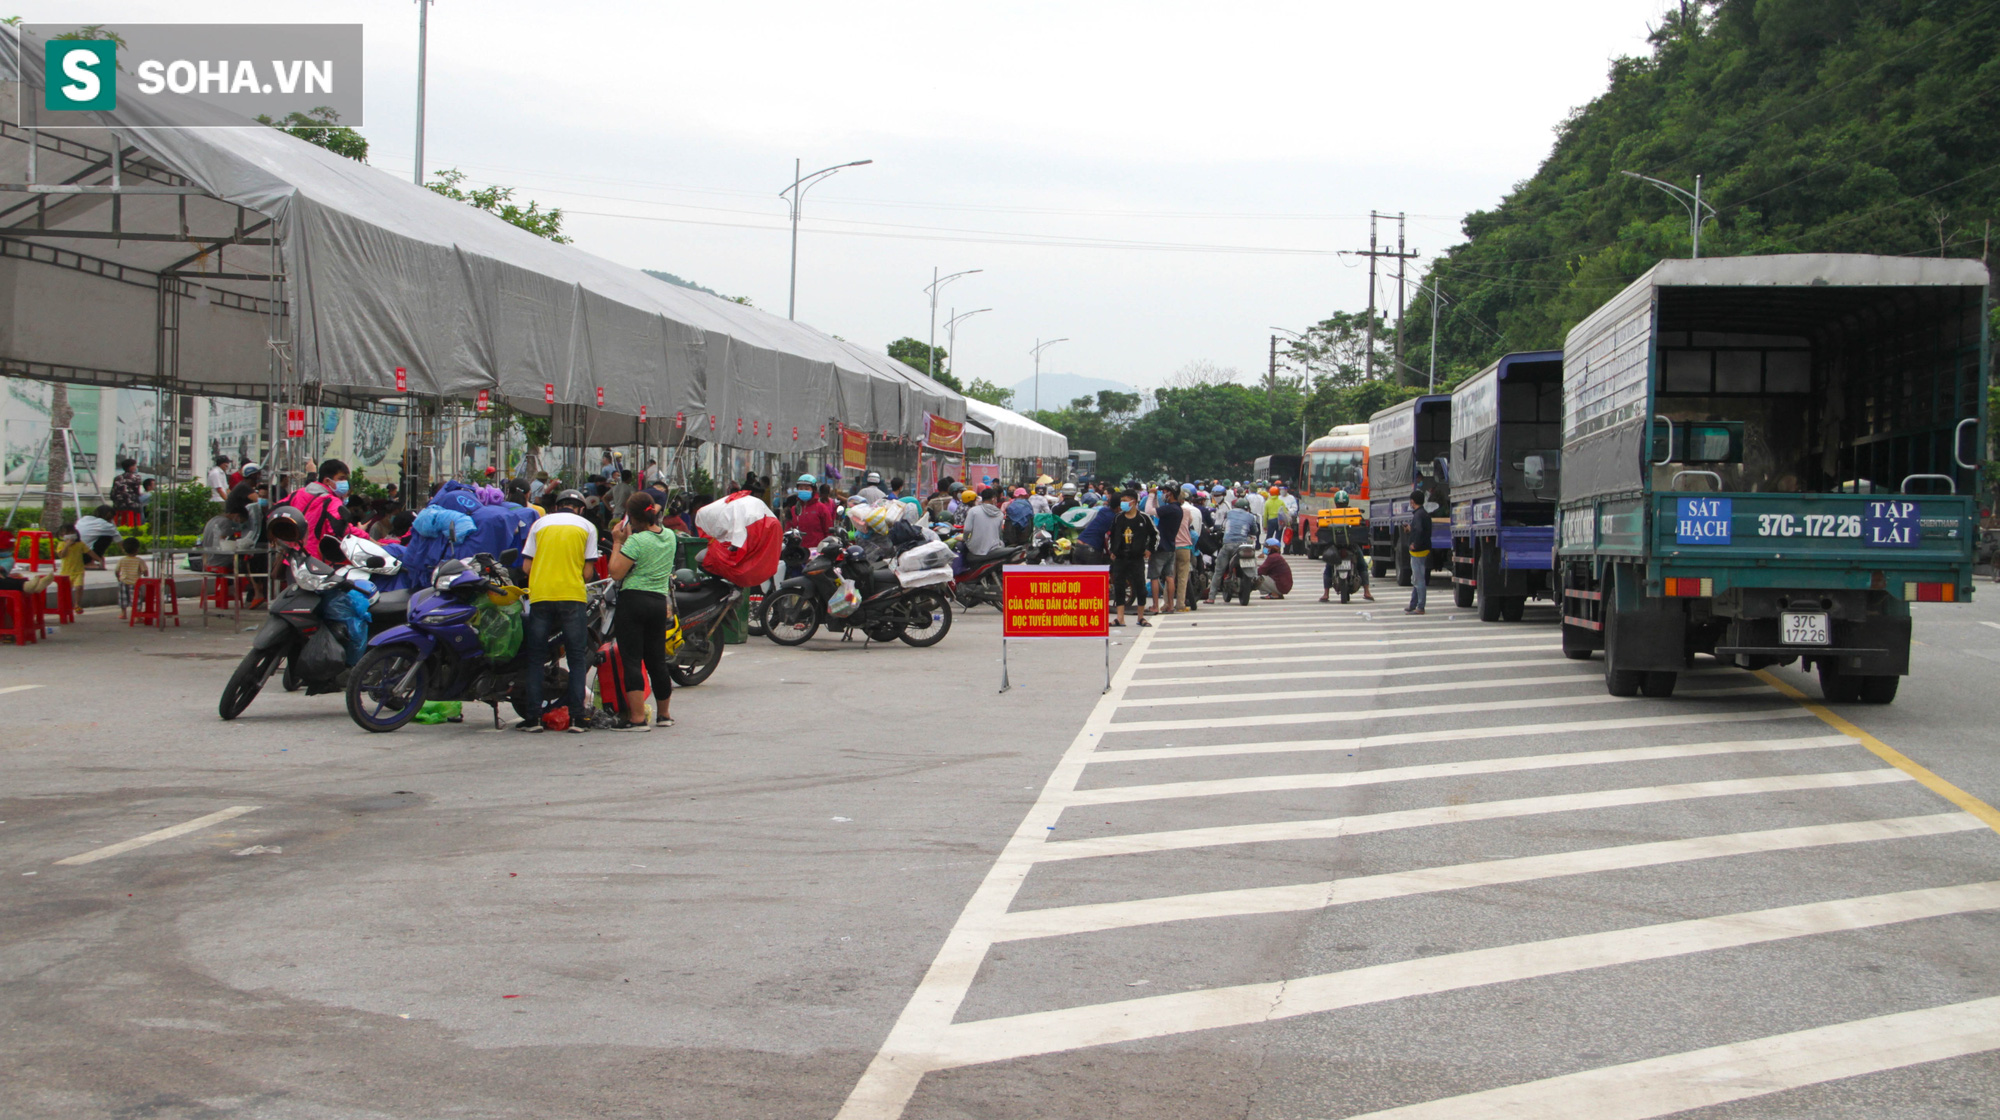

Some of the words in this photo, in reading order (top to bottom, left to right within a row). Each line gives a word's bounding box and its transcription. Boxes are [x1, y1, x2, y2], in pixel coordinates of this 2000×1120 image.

[1688, 498, 1720, 517] SÁT
[1871, 500, 1914, 522] TẬP
[1680, 520, 1728, 541] HẠCH
[1872, 521, 1911, 544] LÁI
[1030, 582, 1038, 596] VỊ
[1039, 580, 1051, 593] TRÍ
[1052, 579, 1067, 593] CHỜ
[1068, 581, 1081, 595] ĐỢI
[1008, 595, 1023, 610] CỦA
[1024, 597, 1044, 610] CÔNG
[1046, 597, 1061, 610] DÂN
[1062, 597, 1077, 610] CÁC
[1079, 596, 1103, 612] HUYỆN
[1012, 615, 1027, 629] DỌC
[1028, 612, 1052, 626] TUYẾN
[1053, 613, 1078, 626] ĐƯỜNG
[1079, 615, 1088, 628] QL
[1089, 615, 1099, 626] 46
[1793, 615, 1816, 628] 37C
[1786, 629, 1826, 643] 172.26
